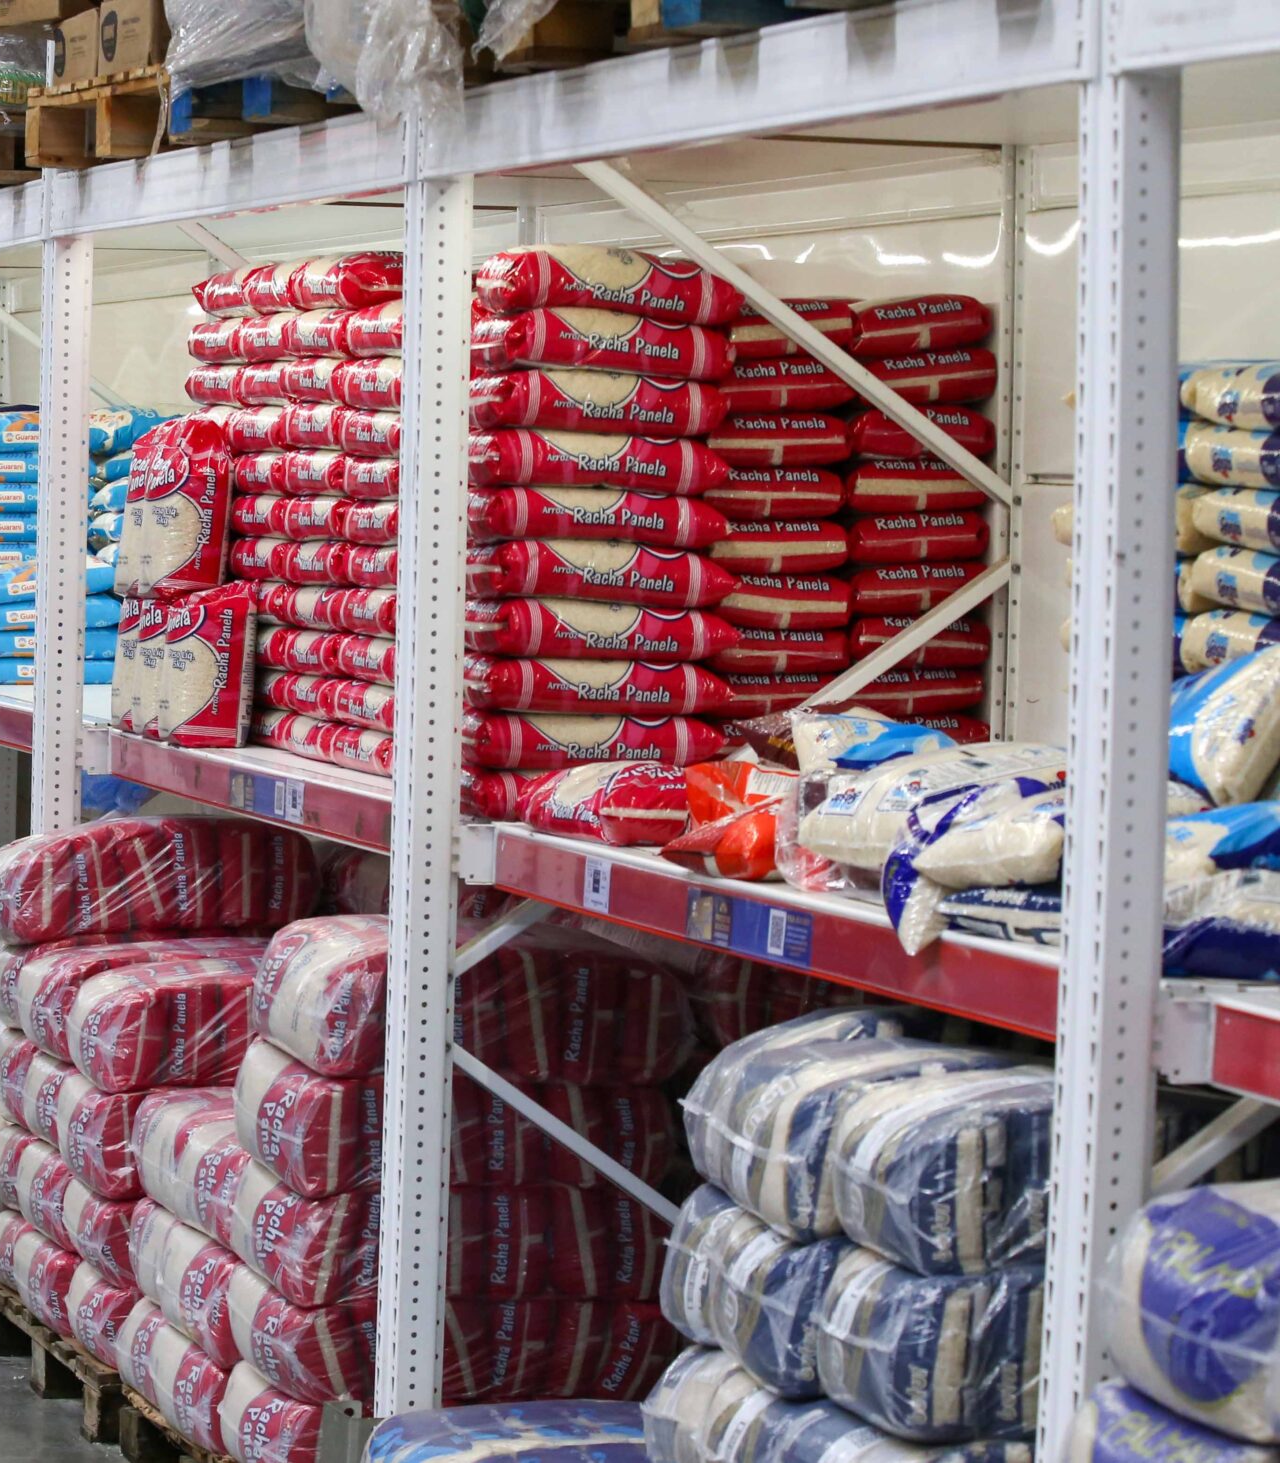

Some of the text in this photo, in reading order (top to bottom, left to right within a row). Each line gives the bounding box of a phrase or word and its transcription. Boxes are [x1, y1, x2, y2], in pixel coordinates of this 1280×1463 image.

[592, 284, 635, 305] Racha
[640, 294, 685, 312] Panela
[874, 300, 962, 320] Racha Panela
[588, 333, 630, 352] Racha
[635, 341, 680, 360] Panela
[884, 351, 971, 370] Racha Panela
[734, 362, 824, 378] Racha Panela
[582, 402, 624, 420] Racha
[629, 405, 674, 424] Panela
[734, 417, 826, 430] Racha Panela
[927, 409, 969, 426] Panela
[547, 453, 667, 477] Arroz Racha Panela
[728, 469, 819, 483] Racha Panela
[200, 468, 216, 504] Panela
[197, 509, 213, 545] Racha
[542, 506, 665, 530] Arroz Racha Panela
[775, 521, 820, 532] Panela
[875, 514, 965, 530] Racha Panela
[582, 567, 624, 587] Racha
[630, 571, 674, 592] Panela
[741, 575, 830, 591] Racha Panela
[877, 565, 965, 580] Racha Panela
[217, 608, 233, 647] Panela
[555, 631, 678, 653] Arroz Racha Panela
[213, 652, 229, 689] Racha
[547, 682, 670, 704] Arroz Racha Panela
[536, 743, 661, 760] Arroz Racha Panela
[76, 853, 88, 892] Panela
[173, 832, 188, 911] Racha Panela
[565, 967, 589, 1062] Racha Panela
[170, 993, 187, 1076] Racha Panela
[270, 1088, 297, 1157] Racha
[362, 1089, 379, 1134] Panela
[261, 1102, 276, 1162] Panel
[488, 1130, 505, 1171] Racha
[264, 1191, 299, 1252] Racha
[362, 1195, 381, 1242] Panela
[491, 1195, 510, 1284] Racha Panela
[616, 1200, 634, 1283] Racha Panela
[602, 1354, 632, 1392] Racha
[252, 1398, 285, 1458] Racha
